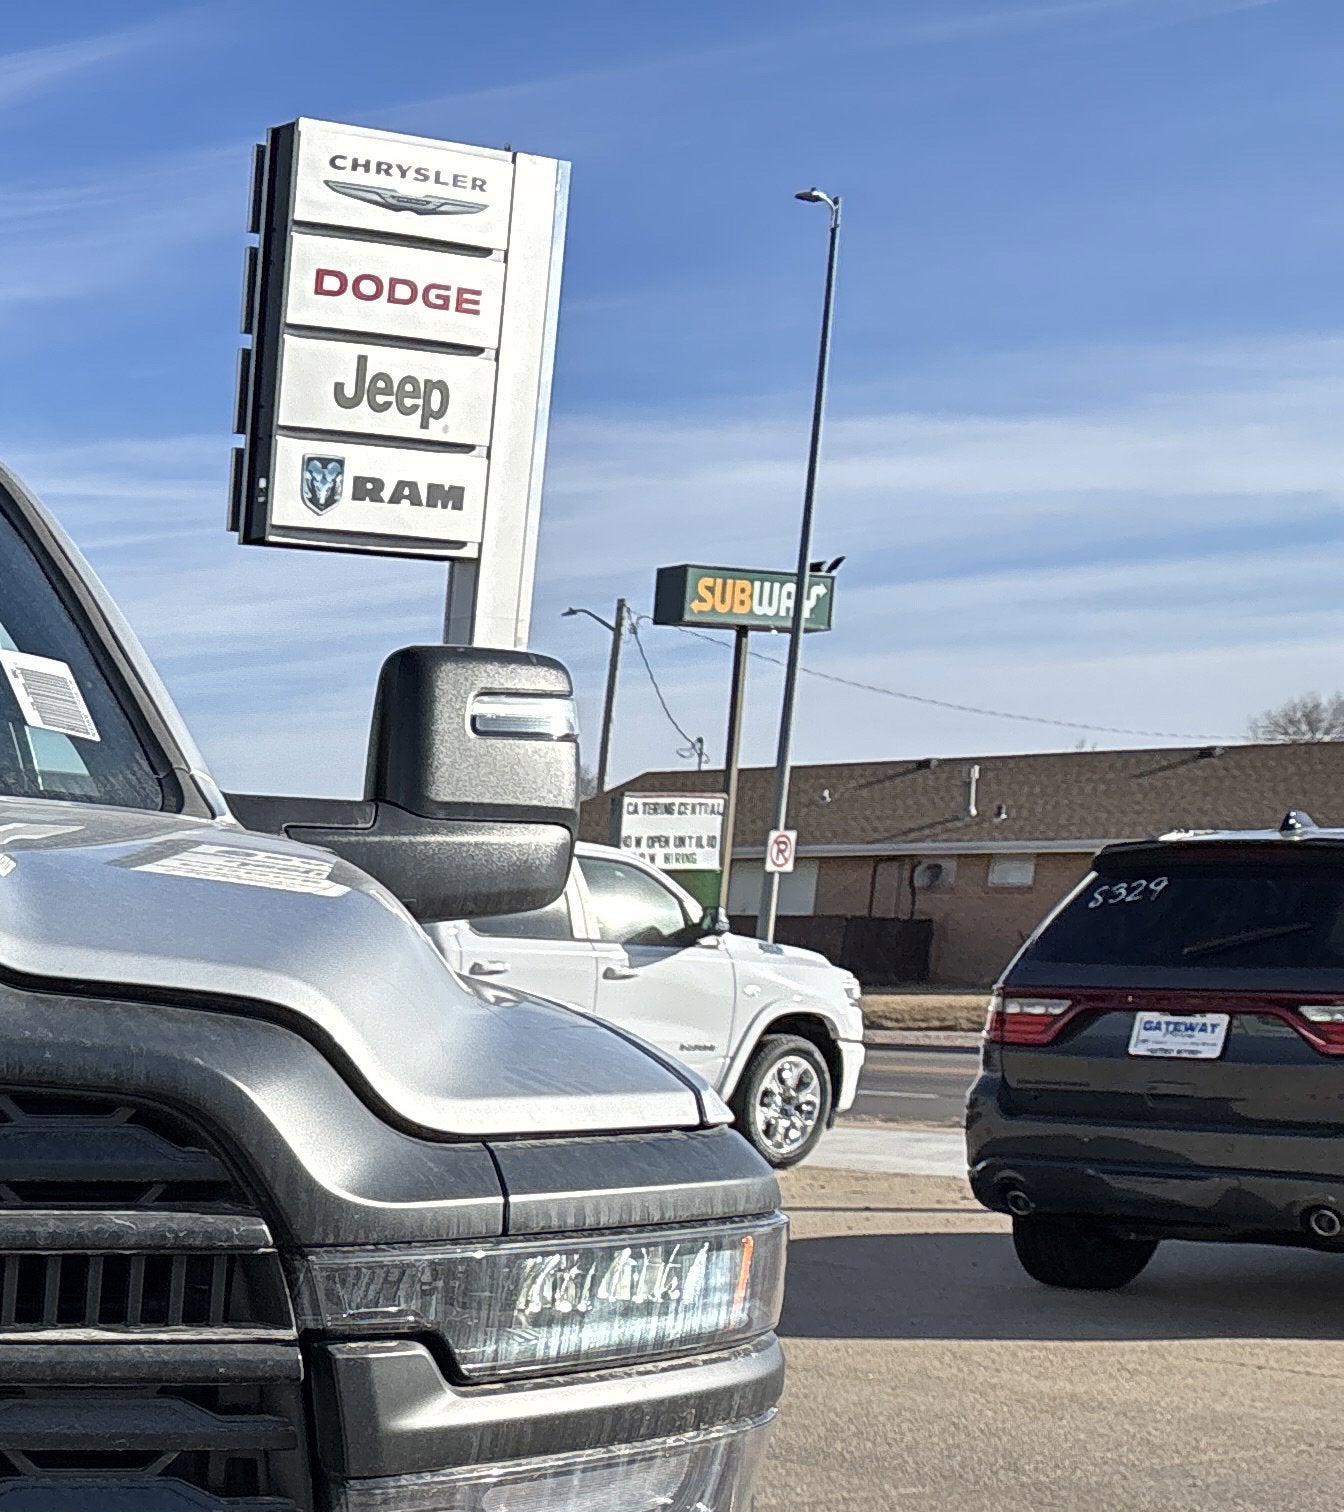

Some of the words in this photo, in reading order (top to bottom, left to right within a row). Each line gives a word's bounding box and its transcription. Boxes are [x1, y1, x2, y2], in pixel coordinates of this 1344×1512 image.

[329, 154, 488, 193] CHRYSLER
[314, 268, 483, 316] DODGE
[333, 354, 450, 430] Jeep
[351, 475, 466, 511] RAM
[689, 576, 828, 619] SUBWAY
[646, 834, 670, 849] OPEN
[673, 834, 705, 849] UNTIL
[1142, 1020, 1221, 1034] GATEWAY
